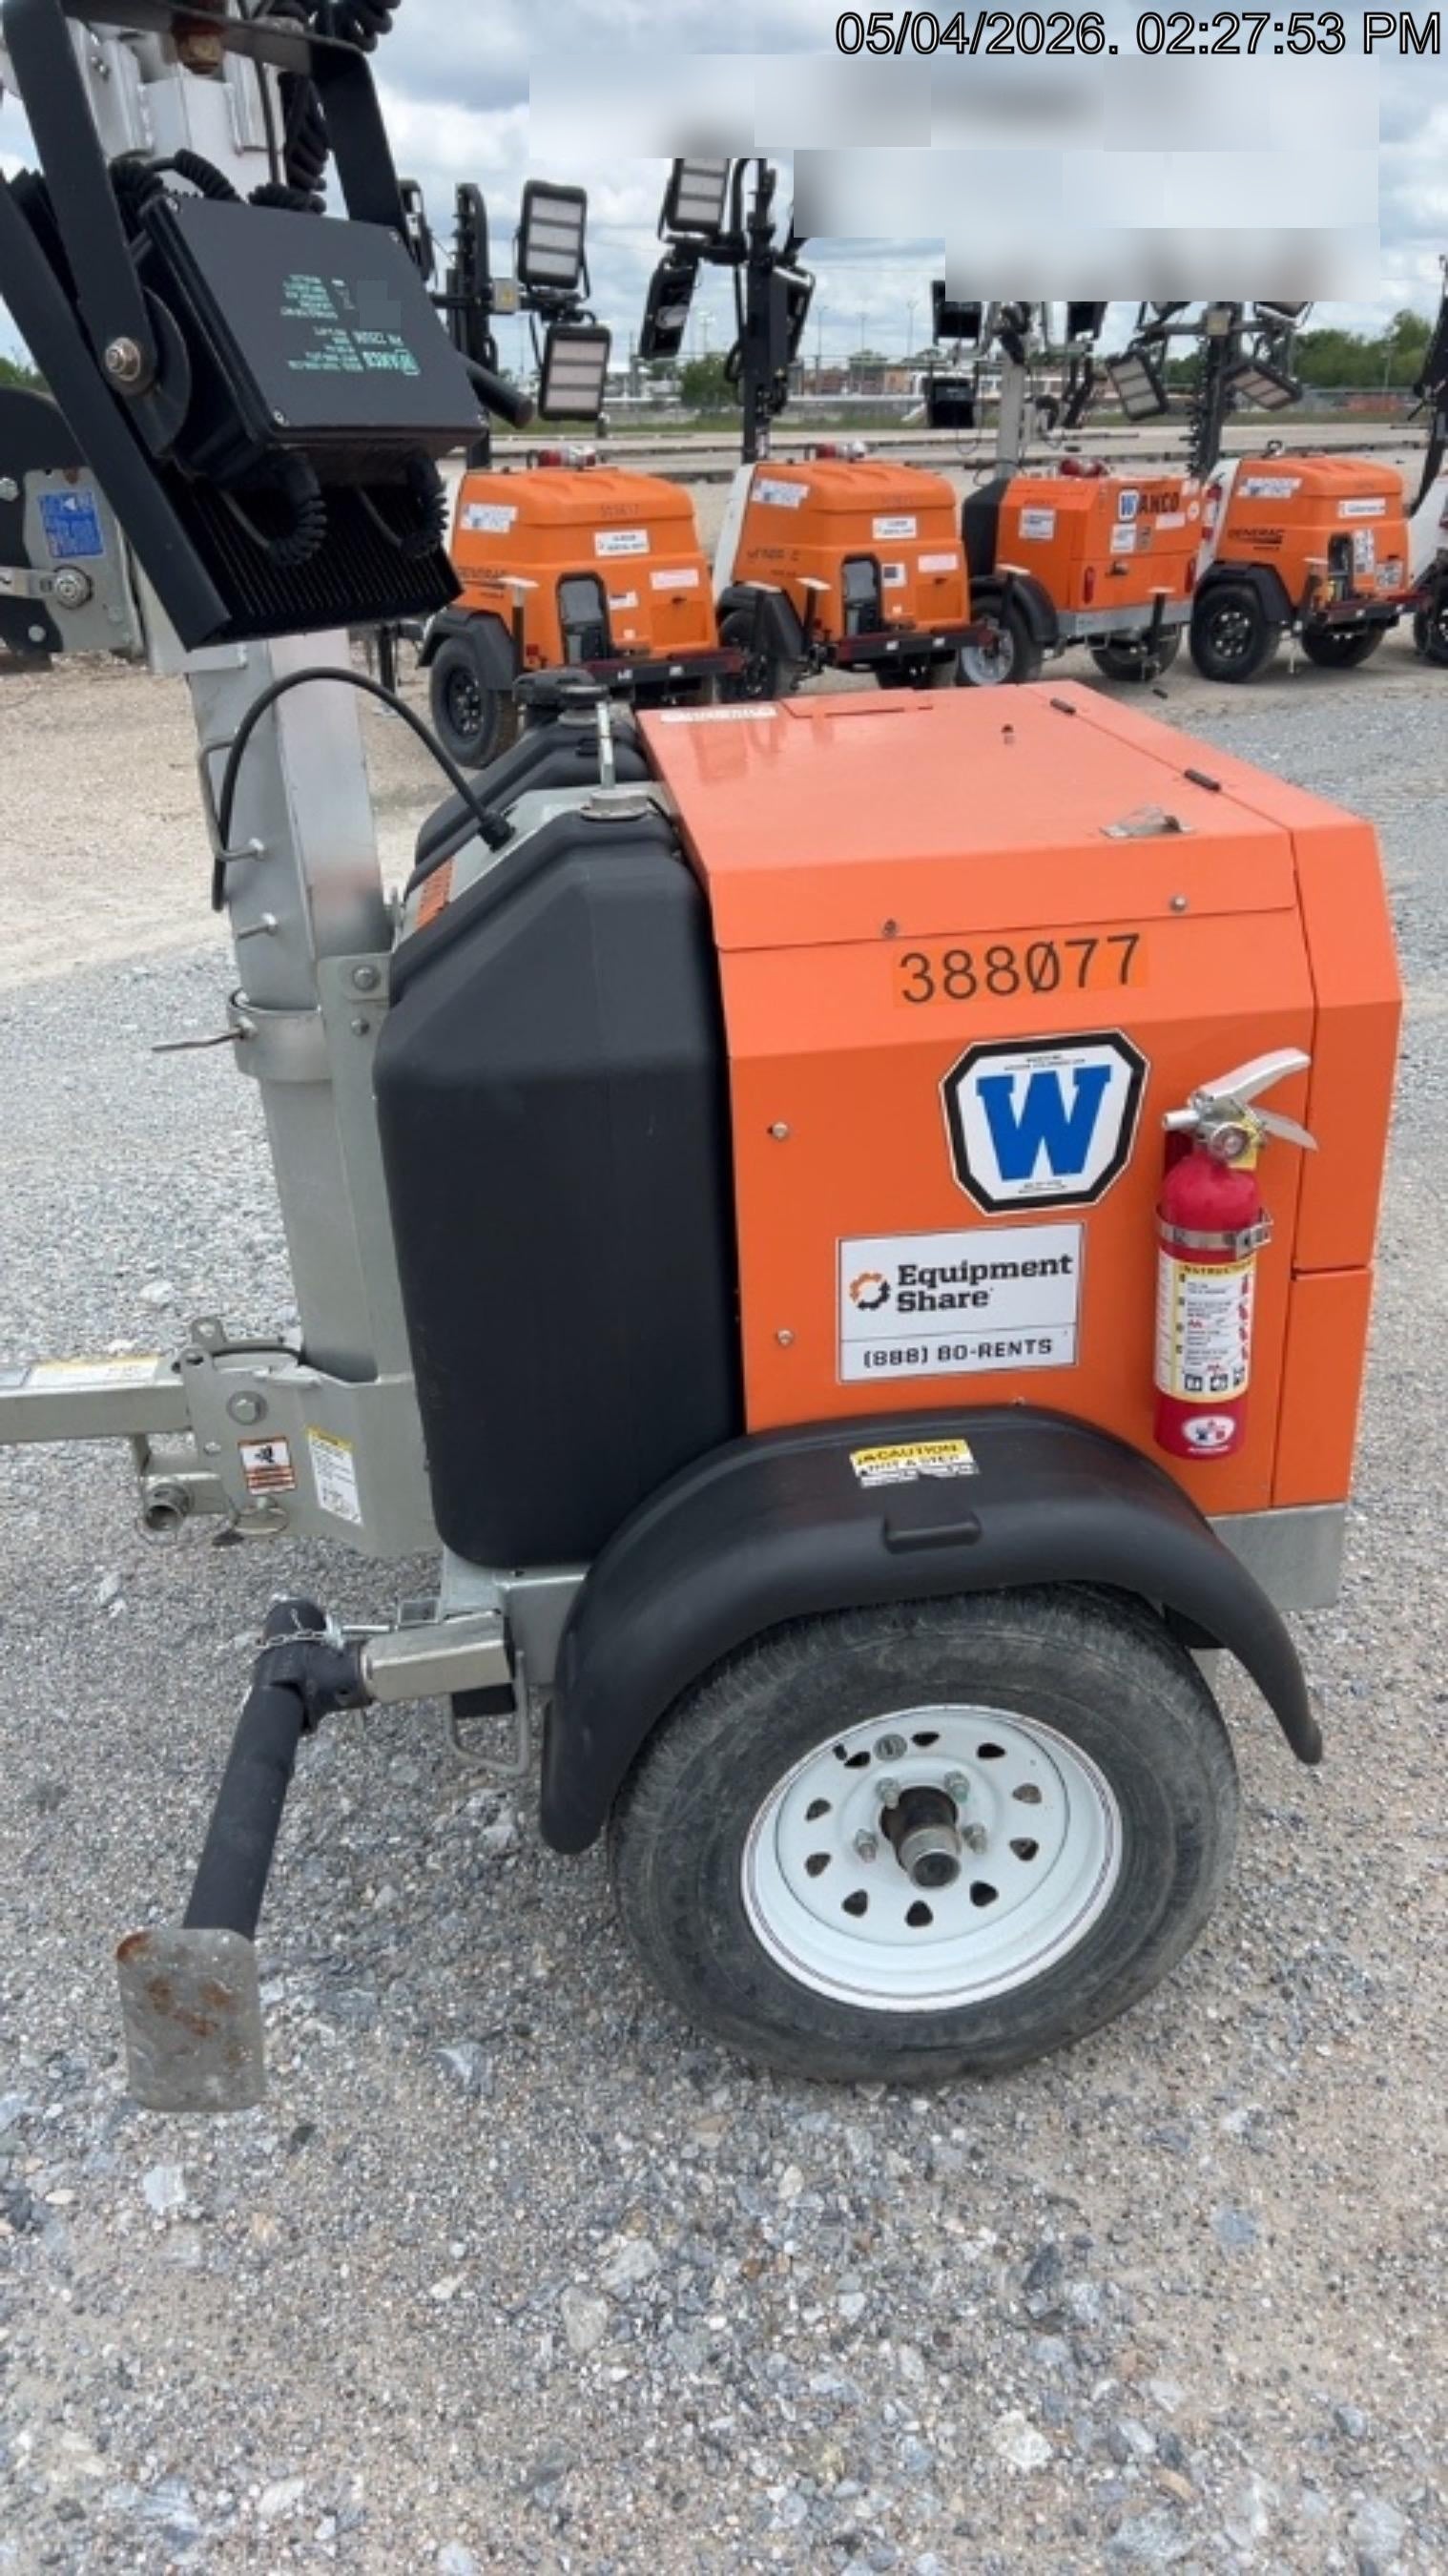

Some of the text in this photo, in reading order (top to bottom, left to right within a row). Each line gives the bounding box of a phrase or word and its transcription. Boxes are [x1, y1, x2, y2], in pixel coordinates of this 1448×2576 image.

[976, 1065, 1111, 1181] W
[898, 1255, 1073, 1288] Equipment
[897, 1289, 989, 1313] Share
[863, 1339, 1052, 1368] (888) 80-RENTS
